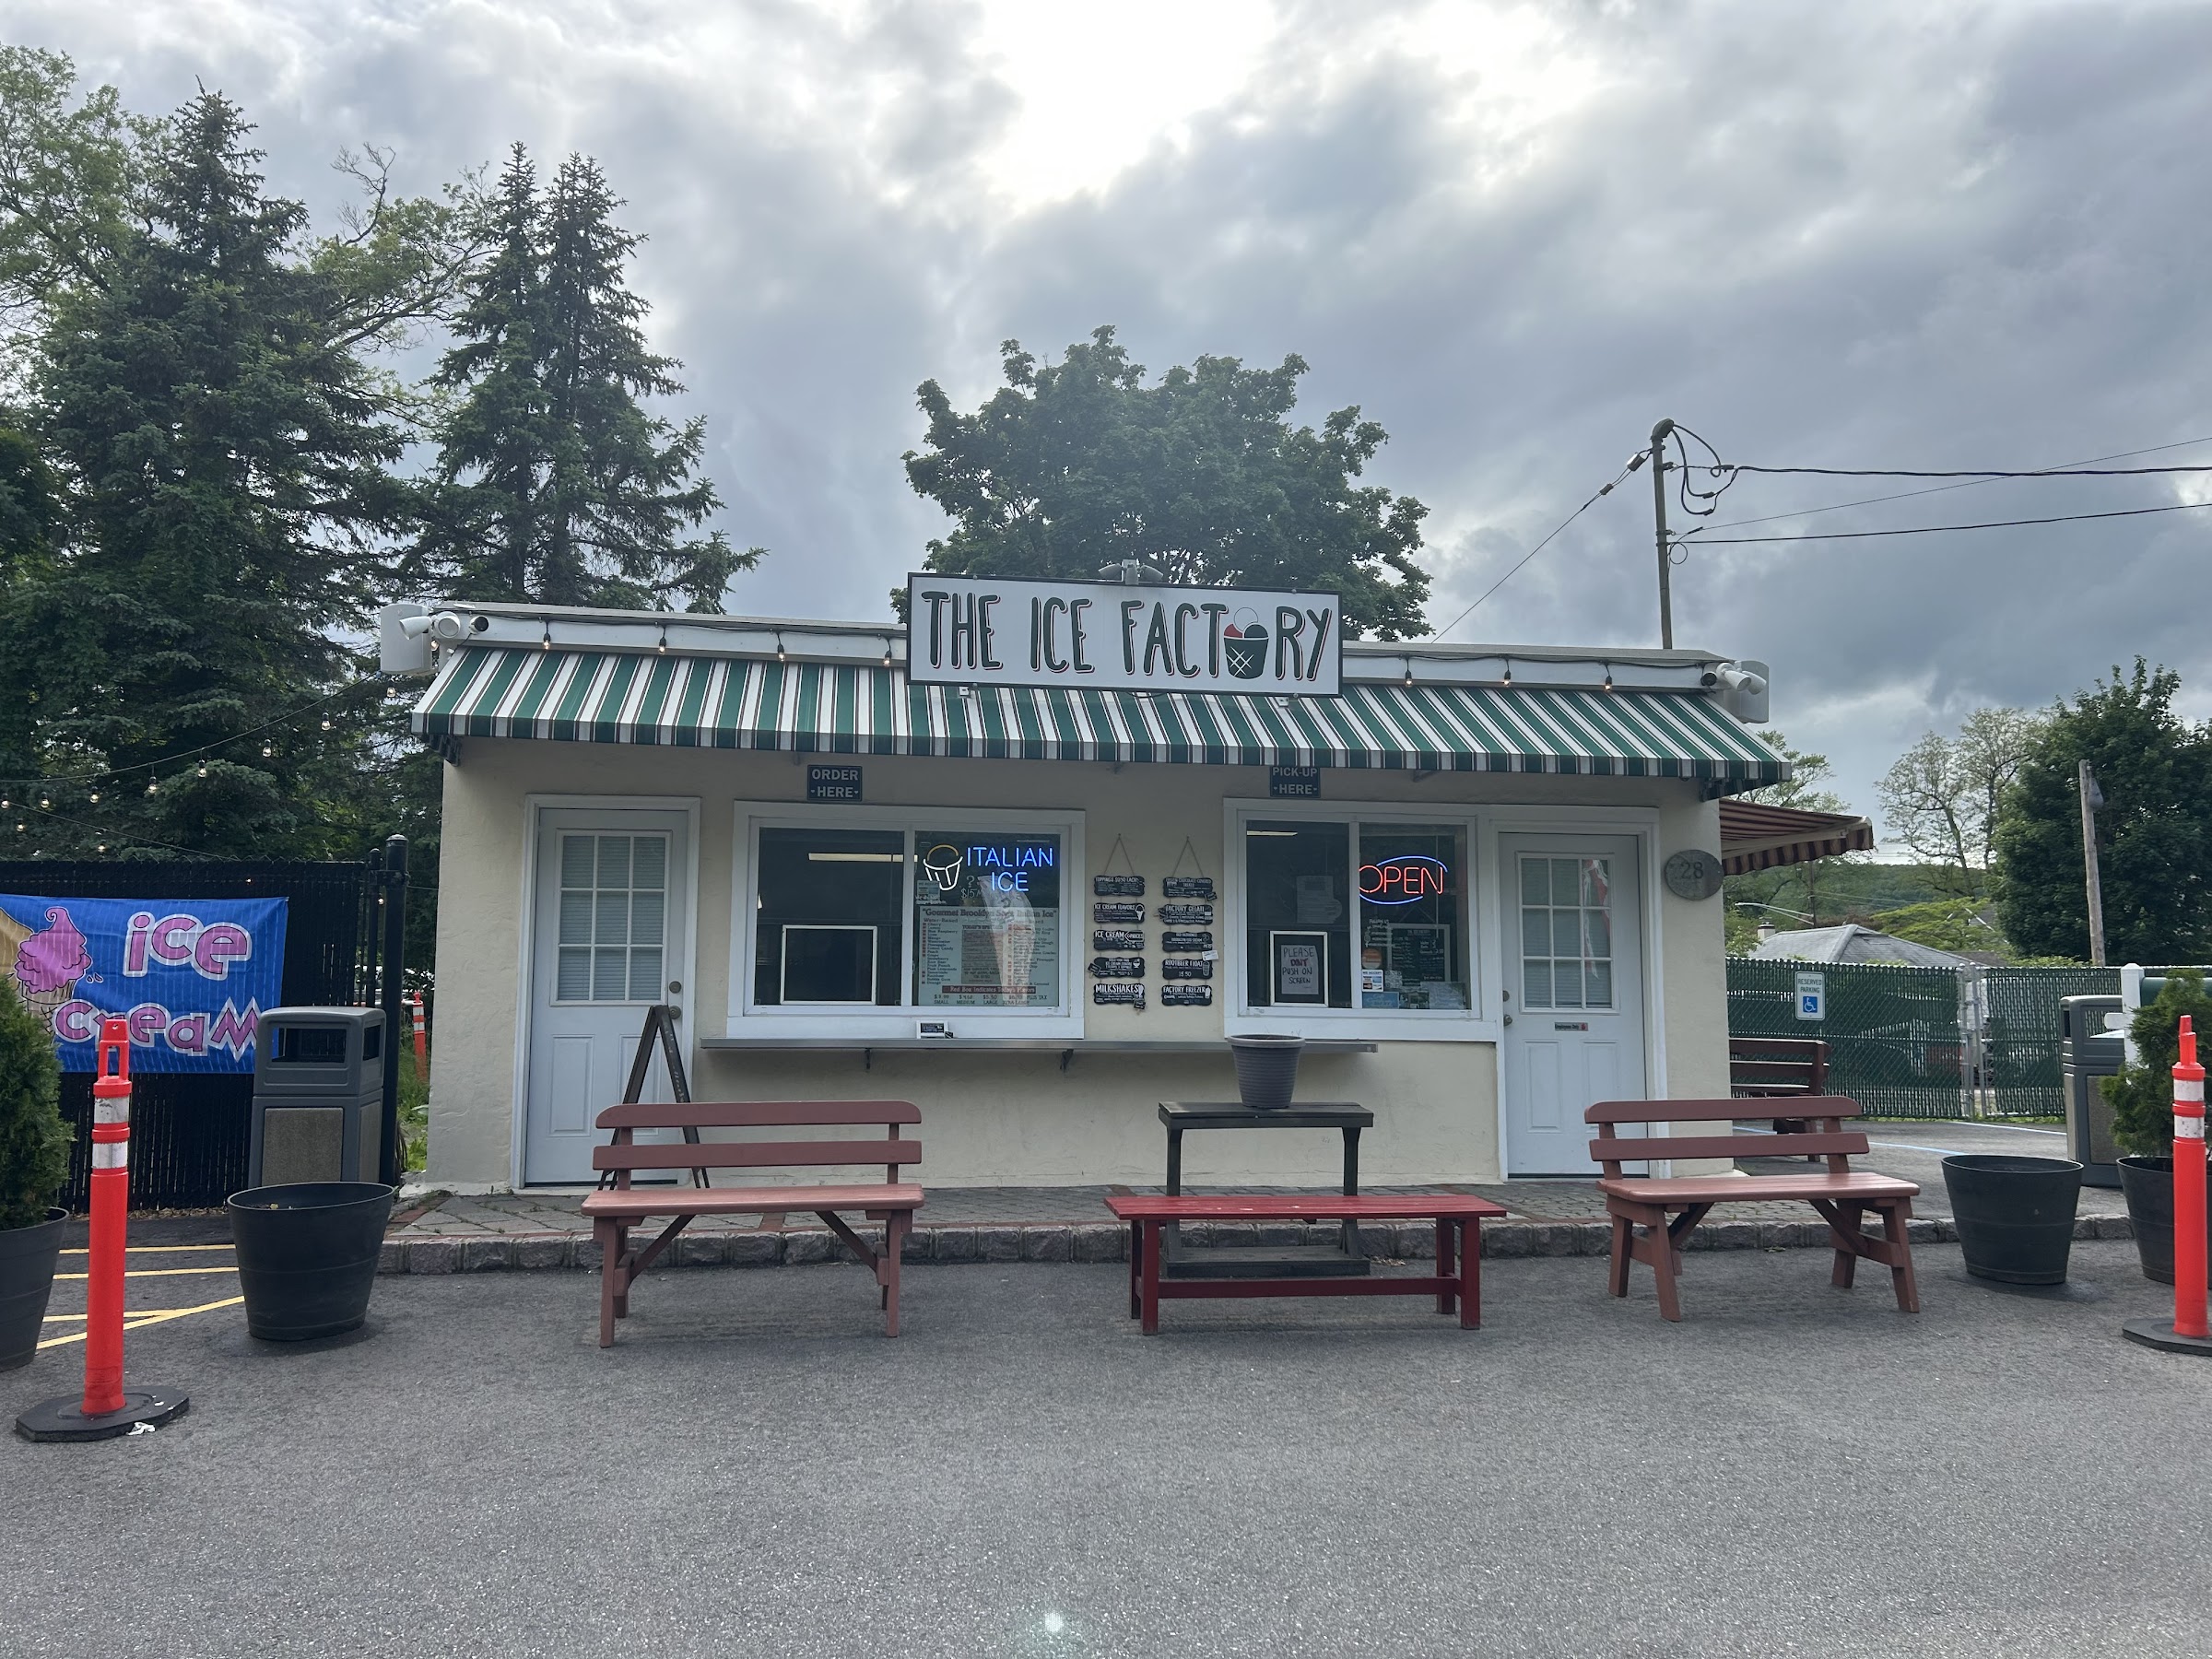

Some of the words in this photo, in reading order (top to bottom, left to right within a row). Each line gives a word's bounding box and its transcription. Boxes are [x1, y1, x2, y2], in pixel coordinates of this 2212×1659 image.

[922, 591, 1003, 670] THE
[1030, 596, 1095, 674] ICE
[812, 769, 858, 781] ORDER
[1272, 767, 1317, 777] PICK-UP
[818, 786, 853, 798] HERE
[1279, 783, 1312, 794] HERE
[967, 846, 1053, 867] ITALIAN
[1680, 861, 1704, 879] 28
[991, 871, 1030, 892] ICE
[1359, 865, 1443, 895] OPEN
[1105, 931, 1124, 939] CREAM
[127, 912, 251, 978] ice
[1283, 947, 1314, 958] PLEASE
[1282, 967, 1299, 976] PUSH
[1301, 967, 1312, 975] ON
[1096, 984, 1138, 994] MILKSHAKES
